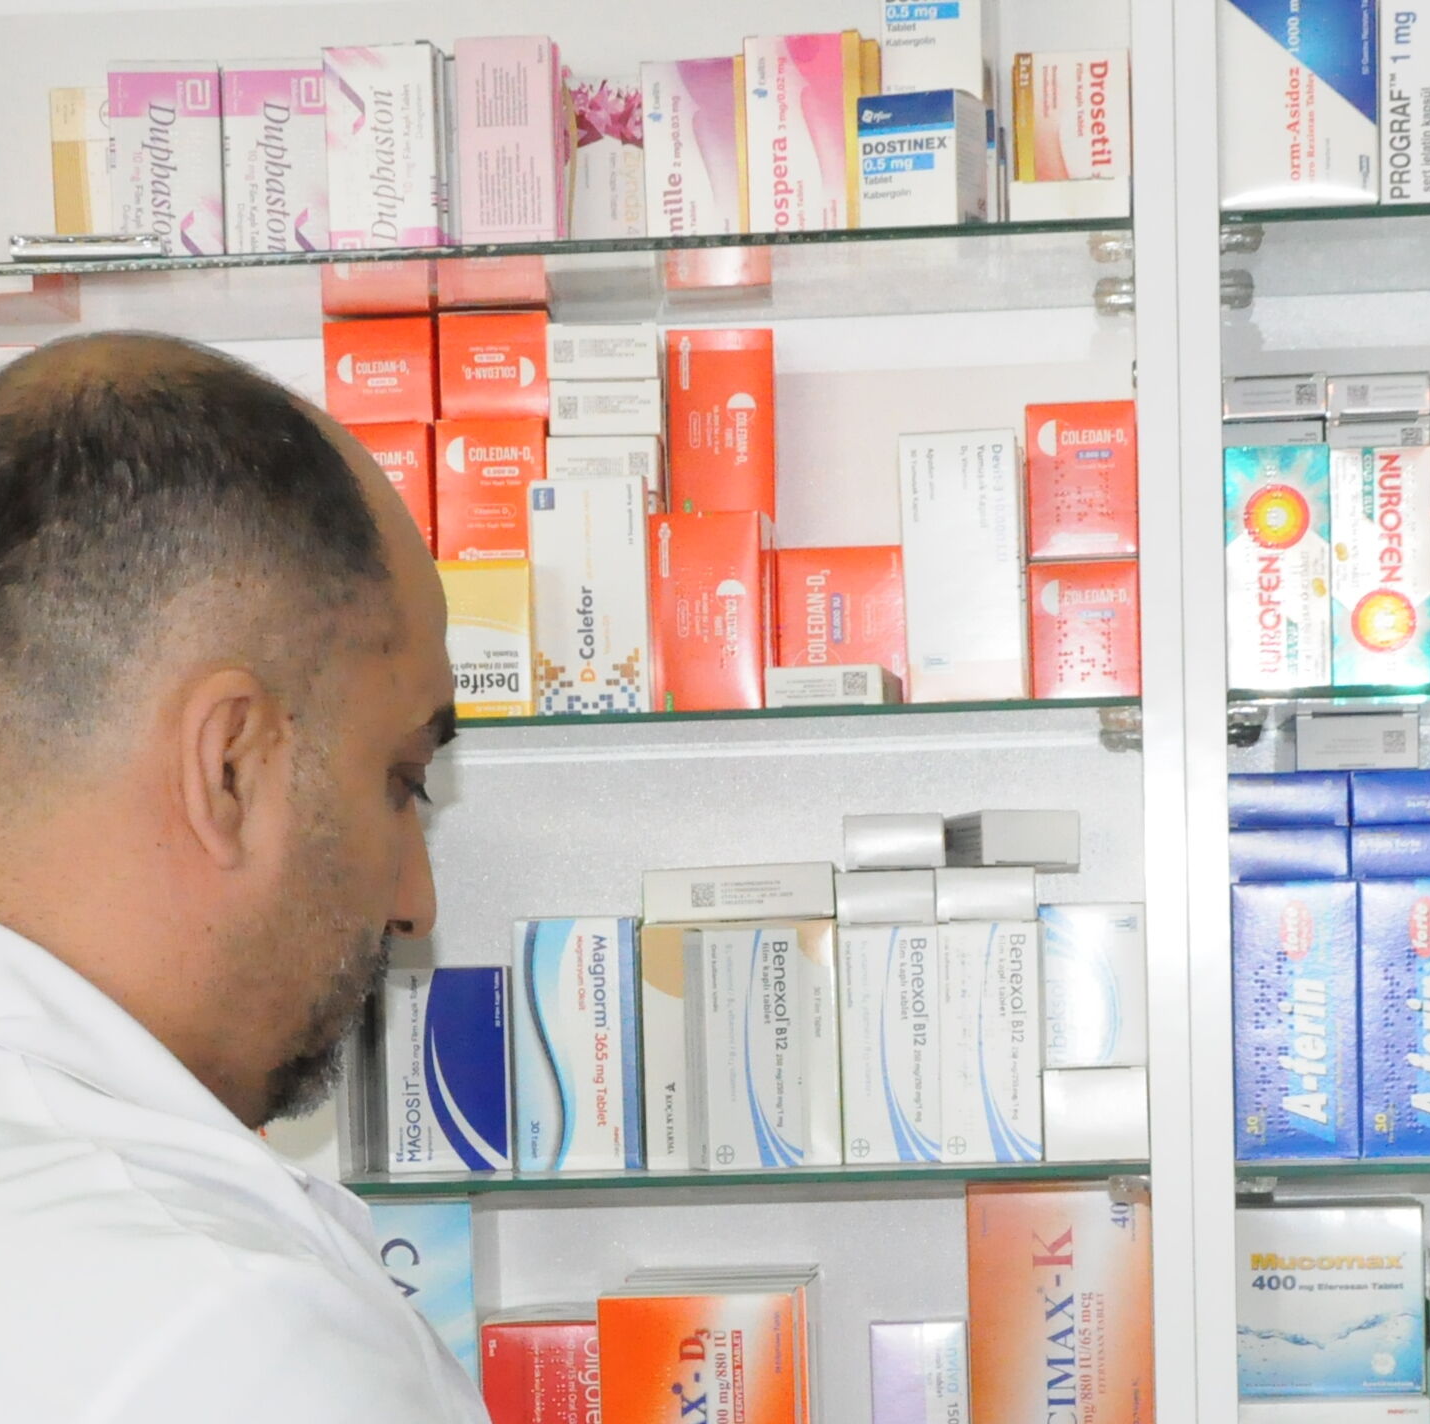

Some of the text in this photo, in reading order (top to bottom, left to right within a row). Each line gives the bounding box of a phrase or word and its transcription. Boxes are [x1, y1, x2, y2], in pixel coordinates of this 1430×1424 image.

[372, 84, 403, 242] Duphaston
[862, 136, 947, 156] DOSTINEX
[863, 157, 887, 172] 0.5
[1090, 60, 1112, 168] Drosetil
[1287, 66, 1301, 183] orm-Asidoz
[1390, 88, 1412, 200] PROGRAF
[1378, 453, 1402, 583] NUROFEN
[577, 585, 596, 682] D-Colefor
[590, 934, 608, 1060] Magnorm 365
[772, 940, 789, 1051] Benexol B12
[910, 937, 927, 1019] Benexol
[1009, 933, 1027, 1016] Benexol
[1282, 975, 1330, 1125] A-ferin
[1250, 1252, 1403, 1270] Mucomax
[1252, 1276, 1297, 1291] 400
